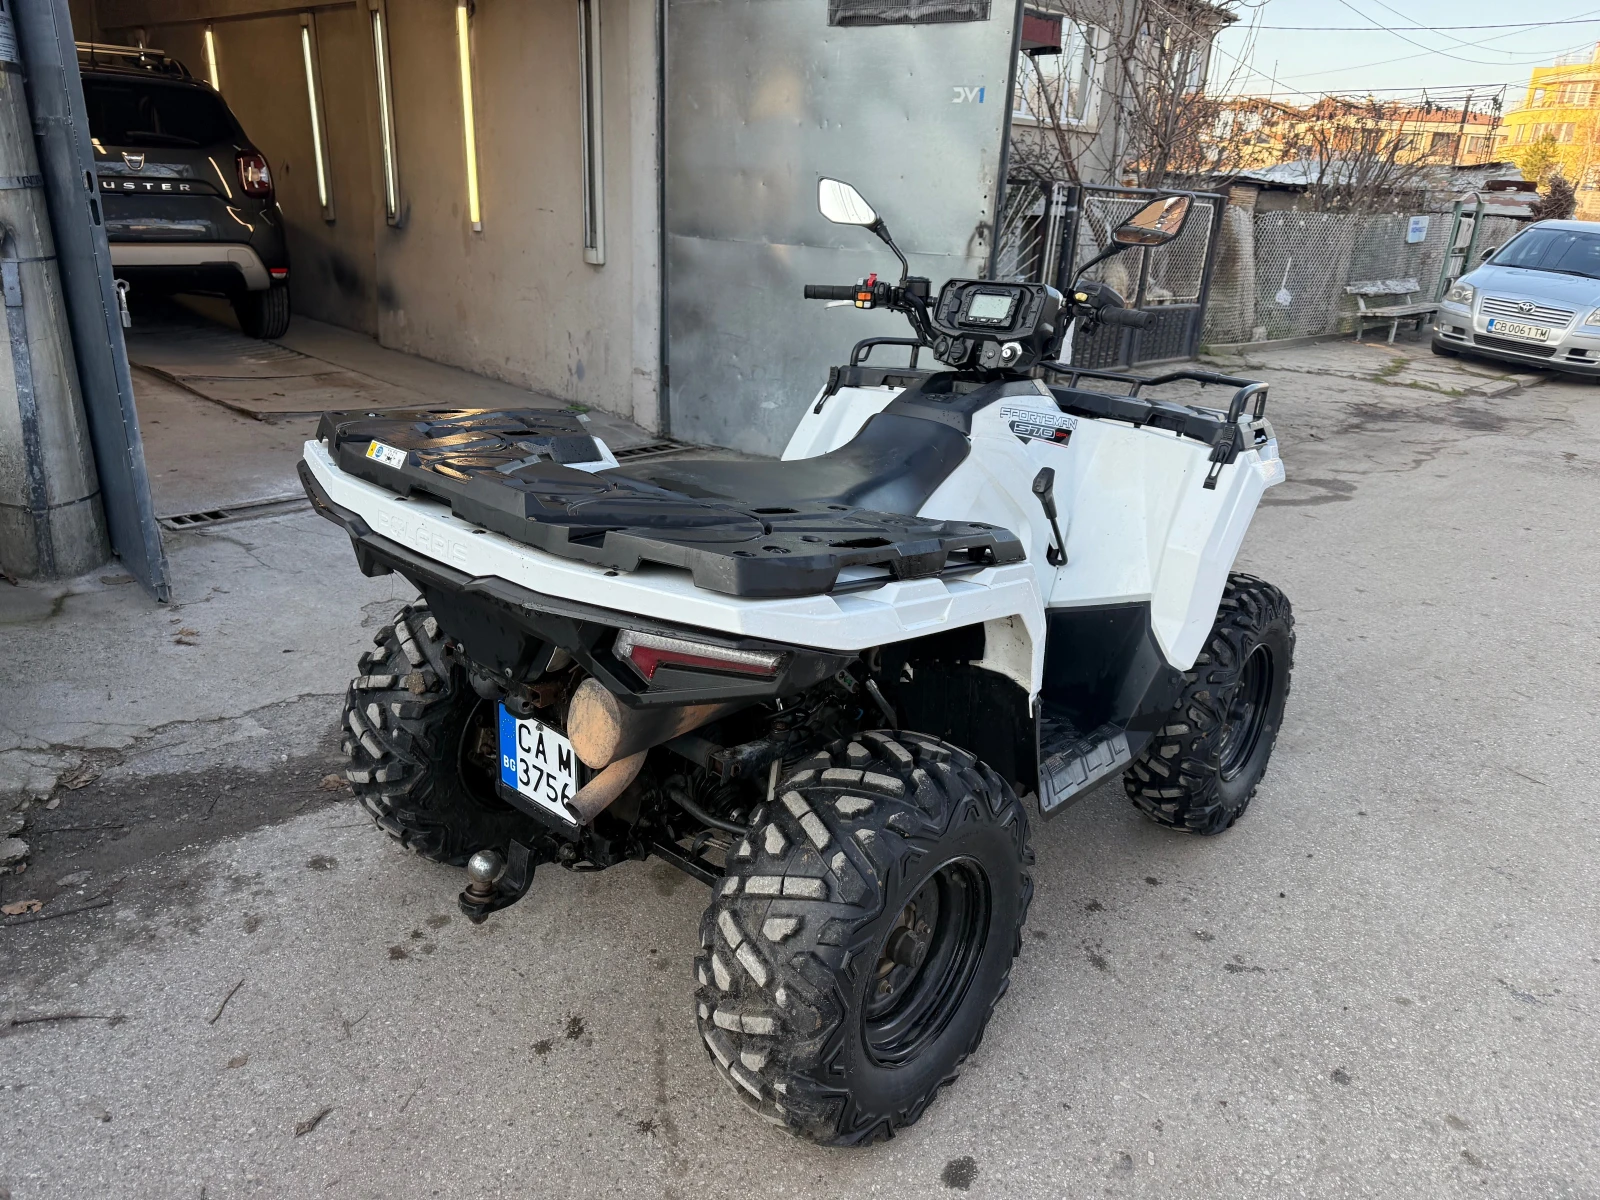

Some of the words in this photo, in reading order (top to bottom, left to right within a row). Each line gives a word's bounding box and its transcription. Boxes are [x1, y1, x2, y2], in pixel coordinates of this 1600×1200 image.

[101, 181, 191, 191] USTER
[1494, 321, 1507, 331] CB
[1508, 324, 1532, 336] 0061
[1534, 327, 1548, 338] TM
[1000, 406, 1079, 430] SPORTSMAN
[1013, 422, 1056, 439] 570
[377, 508, 468, 564] POLARIS
[518, 723, 548, 765] CA
[558, 743, 572, 778] M
[503, 754, 516, 772] BG
